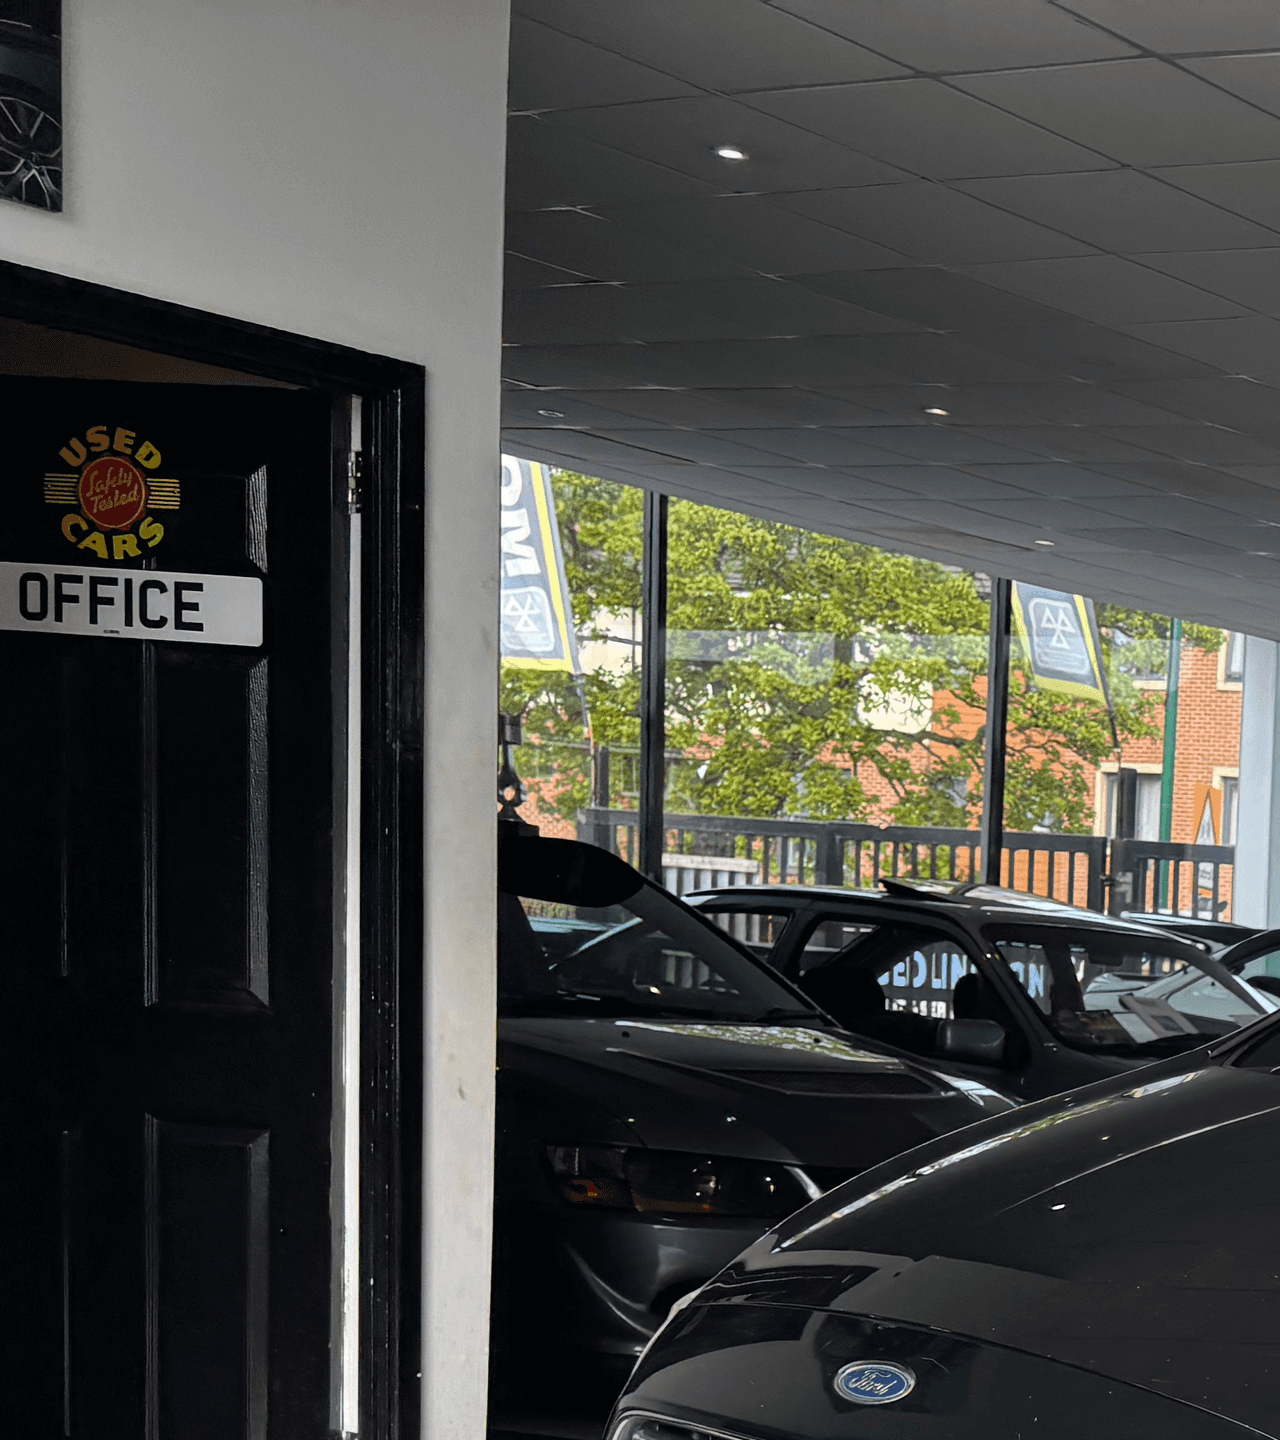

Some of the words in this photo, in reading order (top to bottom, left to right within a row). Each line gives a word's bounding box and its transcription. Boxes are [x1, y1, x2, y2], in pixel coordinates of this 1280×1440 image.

[58, 425, 162, 469] USED
[85, 466, 133, 497] Safety
[90, 483, 141, 514] Tested
[61, 513, 165, 559] CARS
[19, 571, 204, 632] OFFICE
[848, 1369, 898, 1395] Ford
